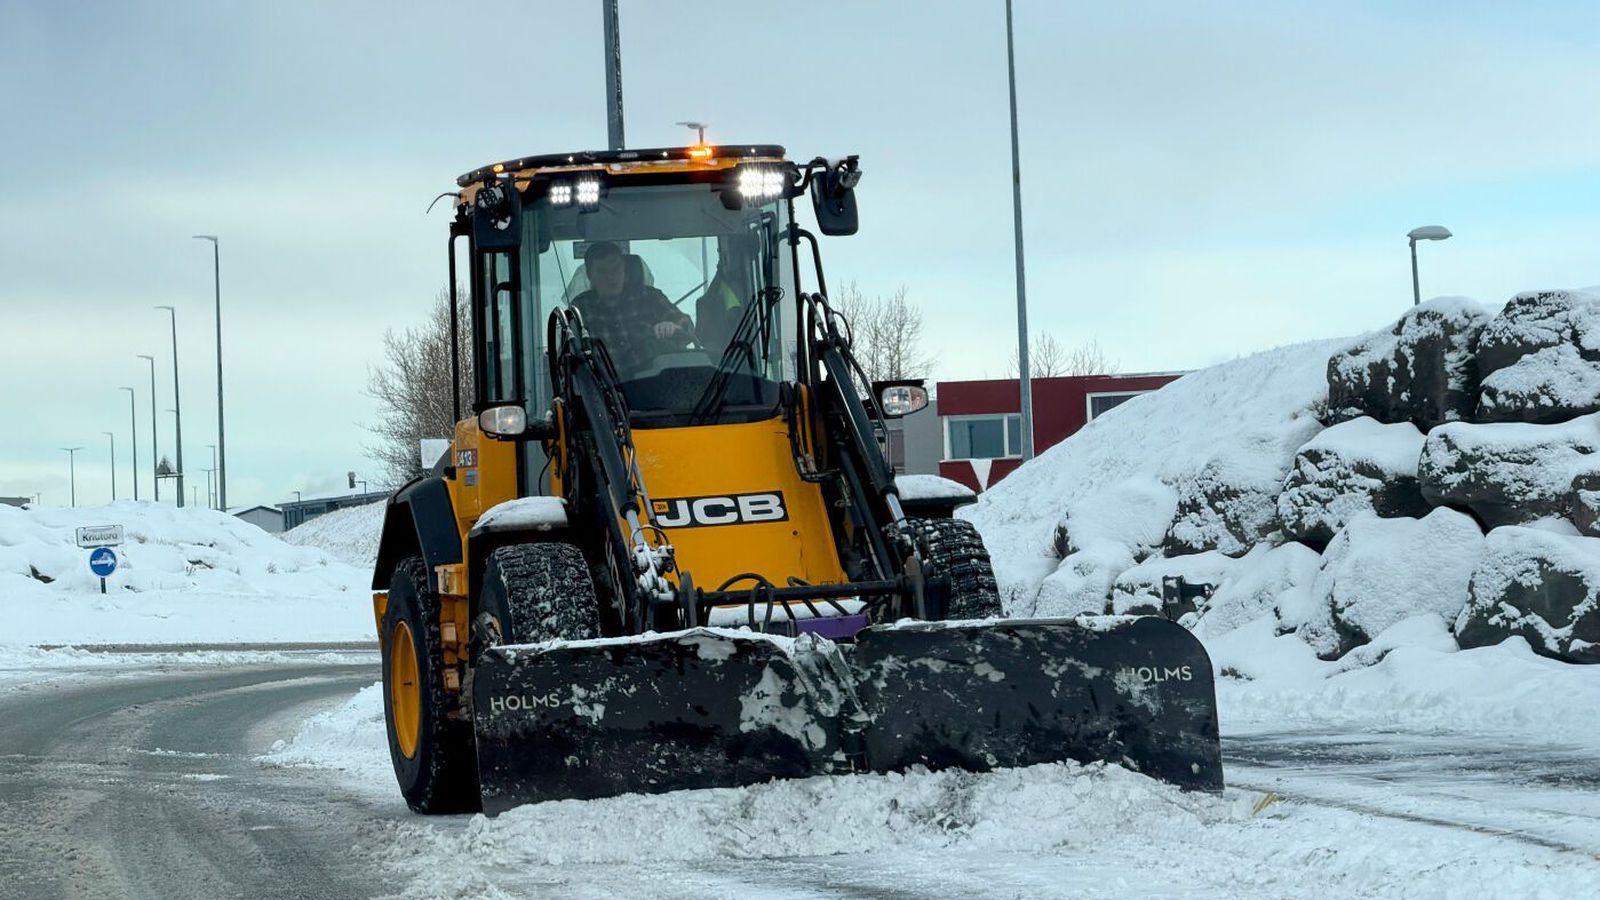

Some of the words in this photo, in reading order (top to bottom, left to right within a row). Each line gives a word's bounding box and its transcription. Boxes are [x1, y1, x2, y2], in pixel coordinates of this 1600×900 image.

[656, 494, 785, 527] JCB
[1121, 666, 1192, 681] HOLMS
[490, 693, 560, 710] HOLMS
